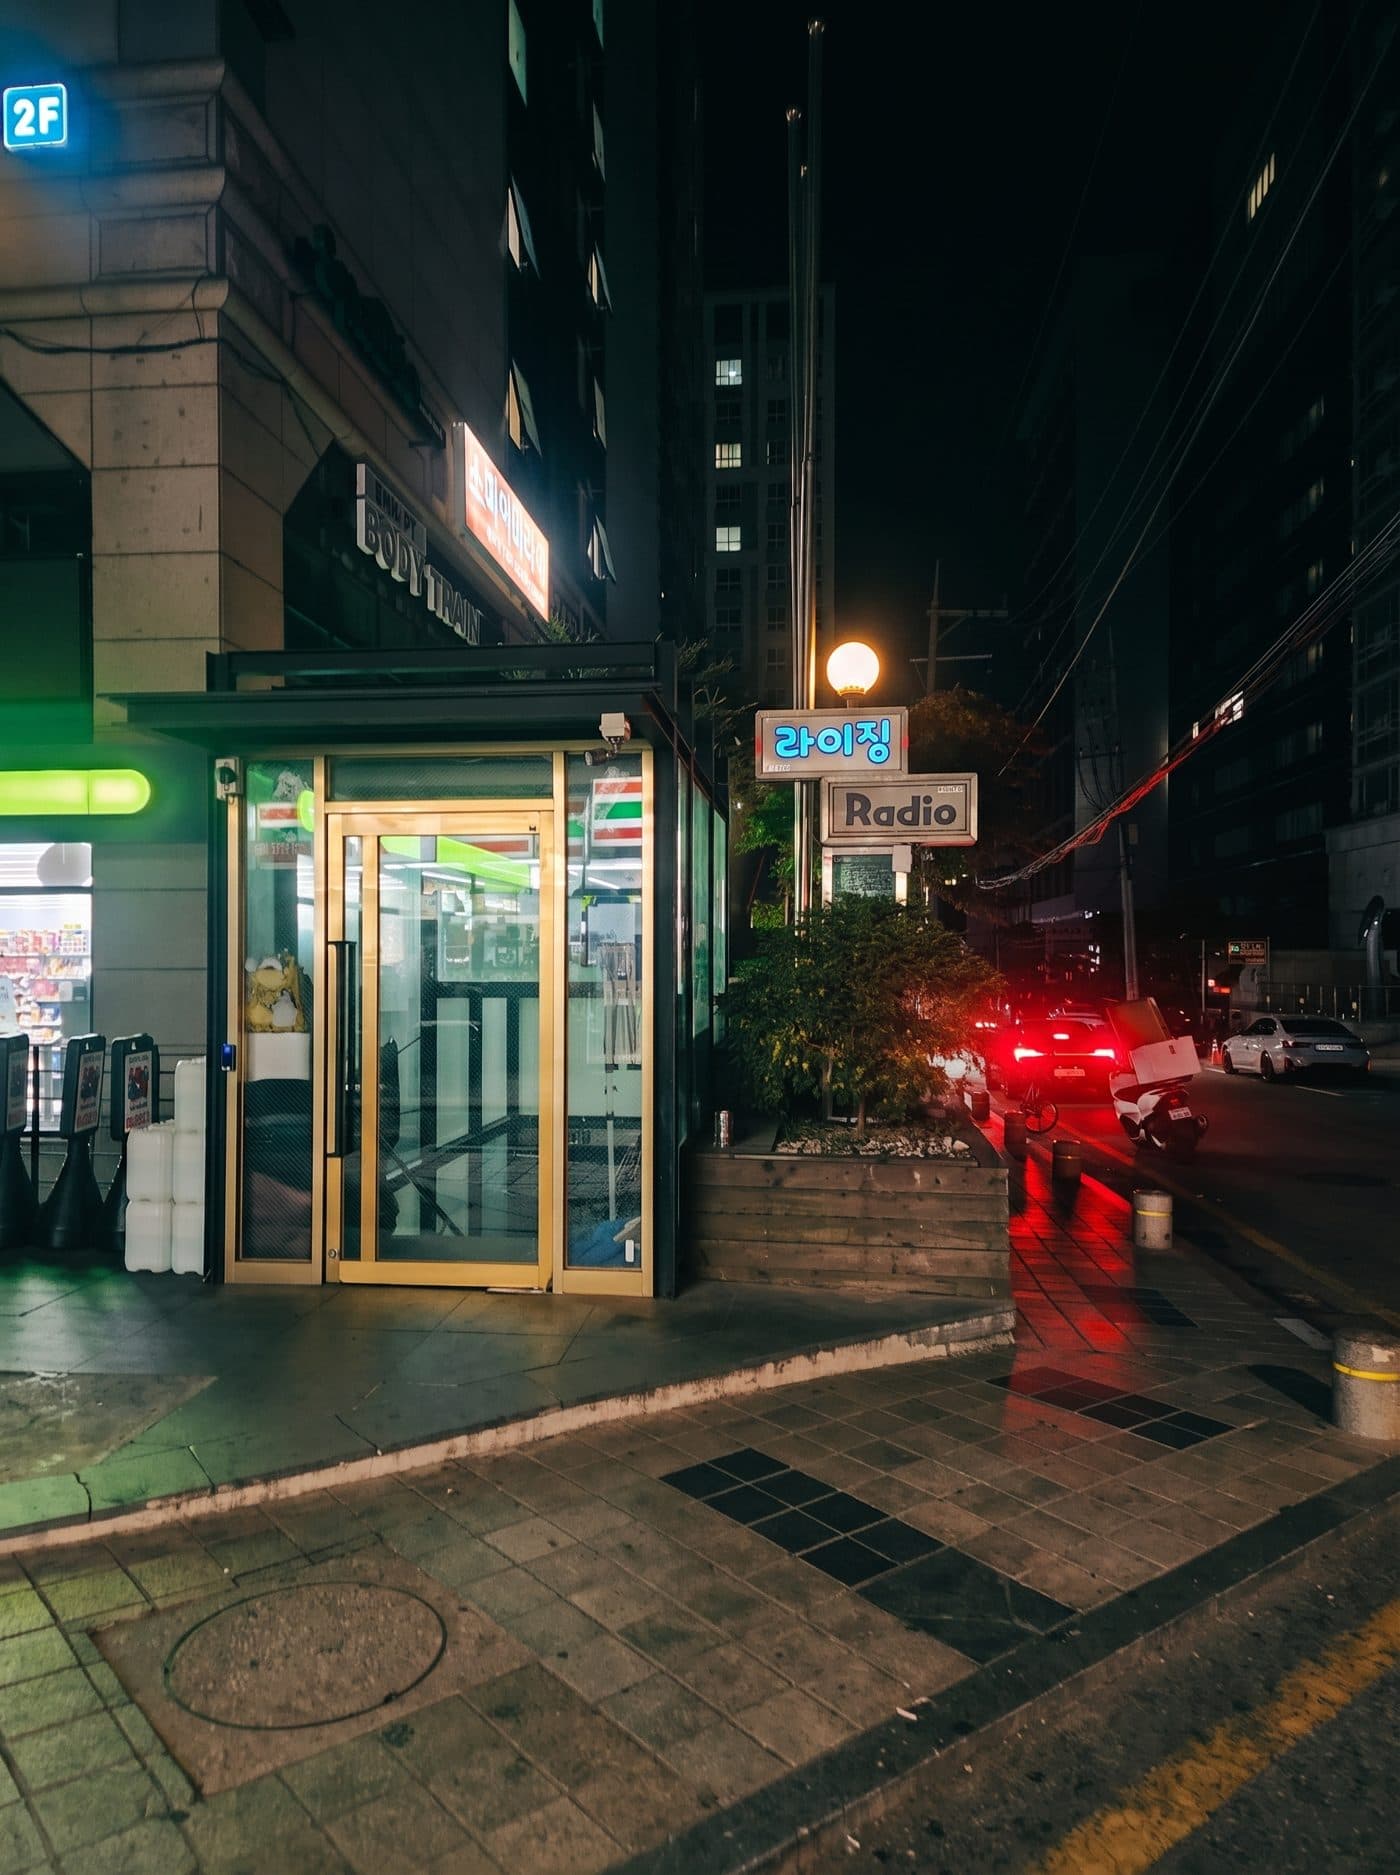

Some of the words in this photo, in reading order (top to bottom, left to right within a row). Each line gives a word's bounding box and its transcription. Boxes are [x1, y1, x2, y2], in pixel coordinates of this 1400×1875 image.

[13, 96, 60, 137] 2F
[357, 498, 426, 598] BODY
[424, 563, 482, 648] TRAIN
[774, 718, 892, 765] 라이징
[845, 792, 957, 827] Radio
